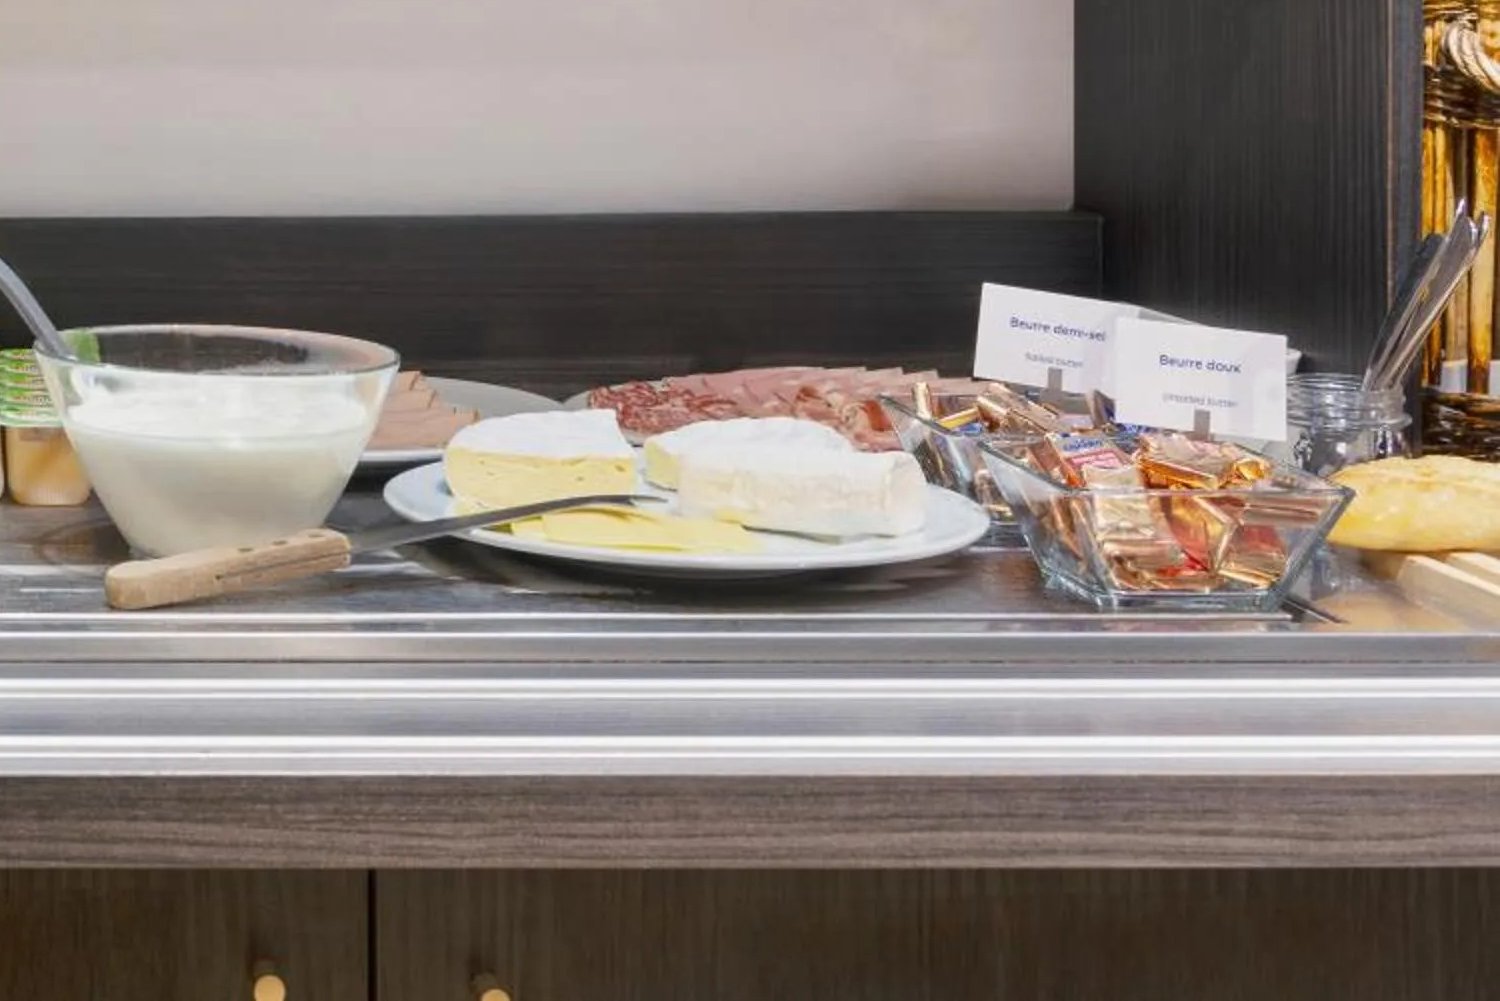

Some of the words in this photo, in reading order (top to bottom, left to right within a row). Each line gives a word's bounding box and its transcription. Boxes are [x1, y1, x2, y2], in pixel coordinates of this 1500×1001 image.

[1010, 316, 1051, 334] Beurre
[1053, 323, 1106, 342] demi-sel
[1159, 354, 1203, 371] Beurre
[1206, 359, 1242, 374] doux
